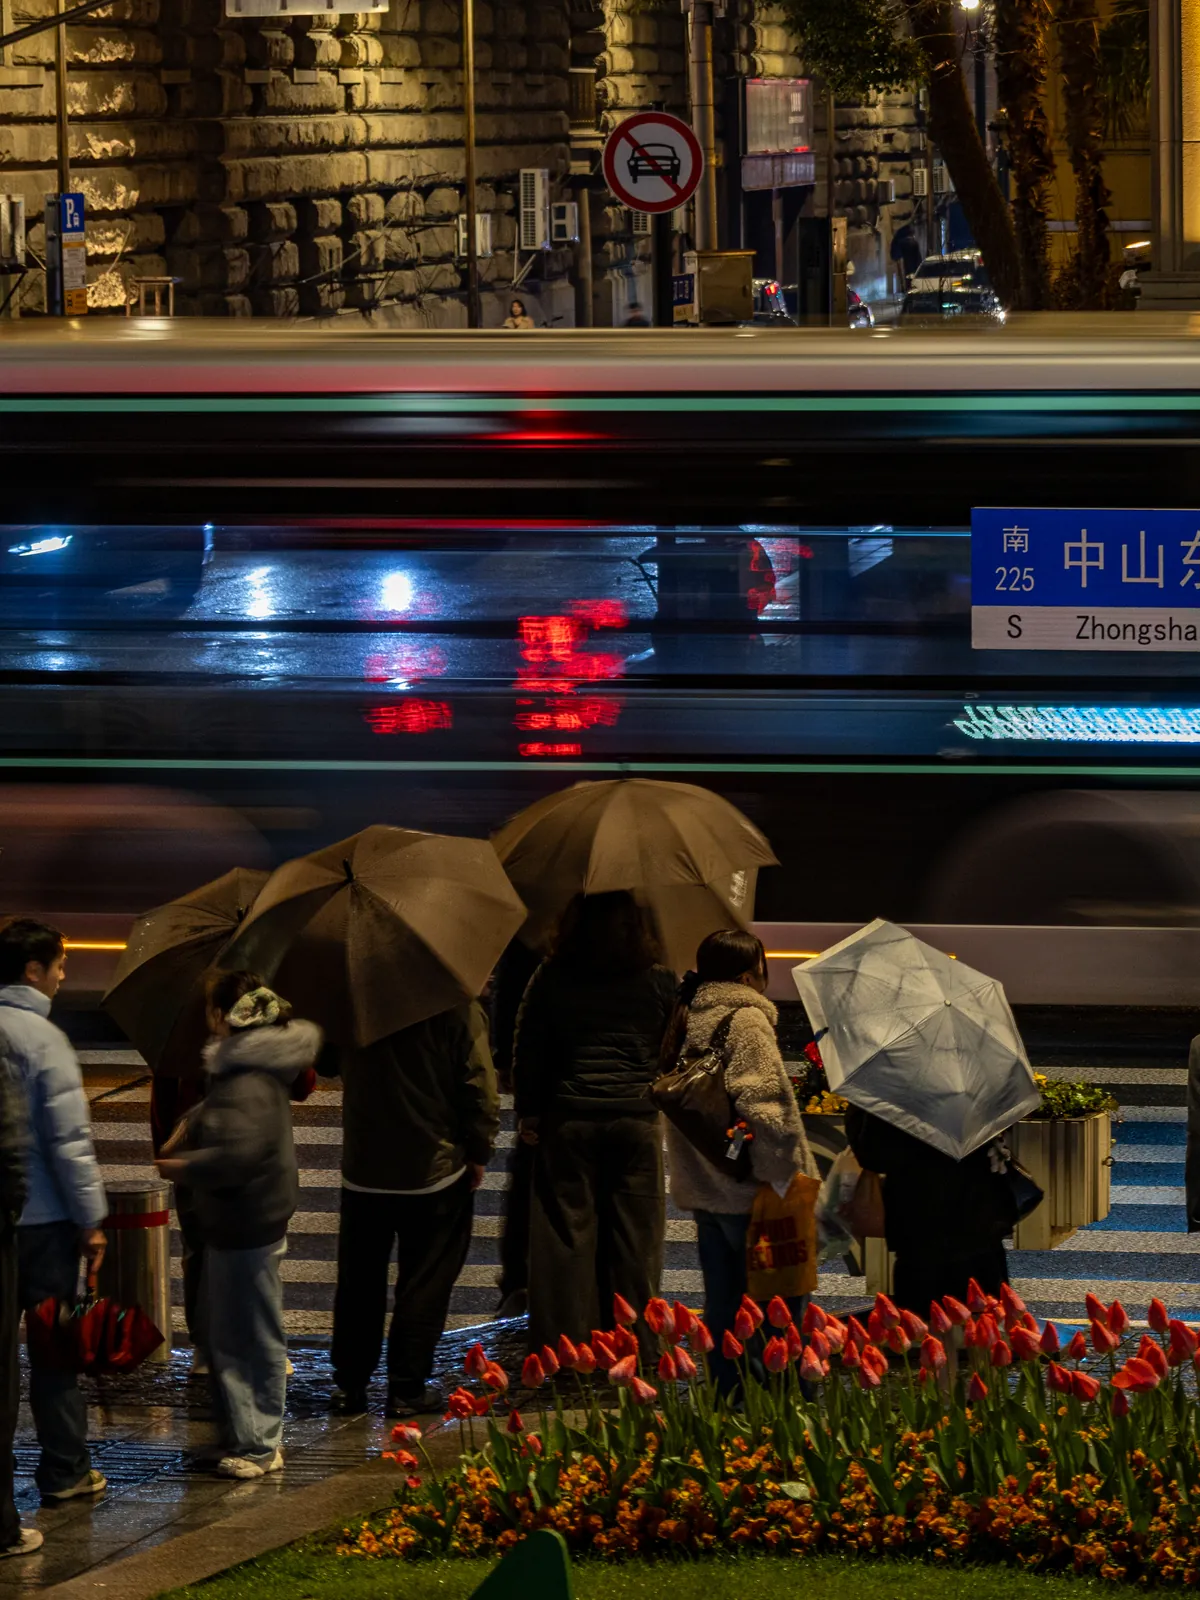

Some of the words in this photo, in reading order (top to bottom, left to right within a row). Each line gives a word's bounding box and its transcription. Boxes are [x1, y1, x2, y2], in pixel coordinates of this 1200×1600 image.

[65, 198, 75, 229] P
[1002, 525, 1029, 553] 南
[995, 566, 1035, 592] 225
[1006, 614, 1023, 639] S
